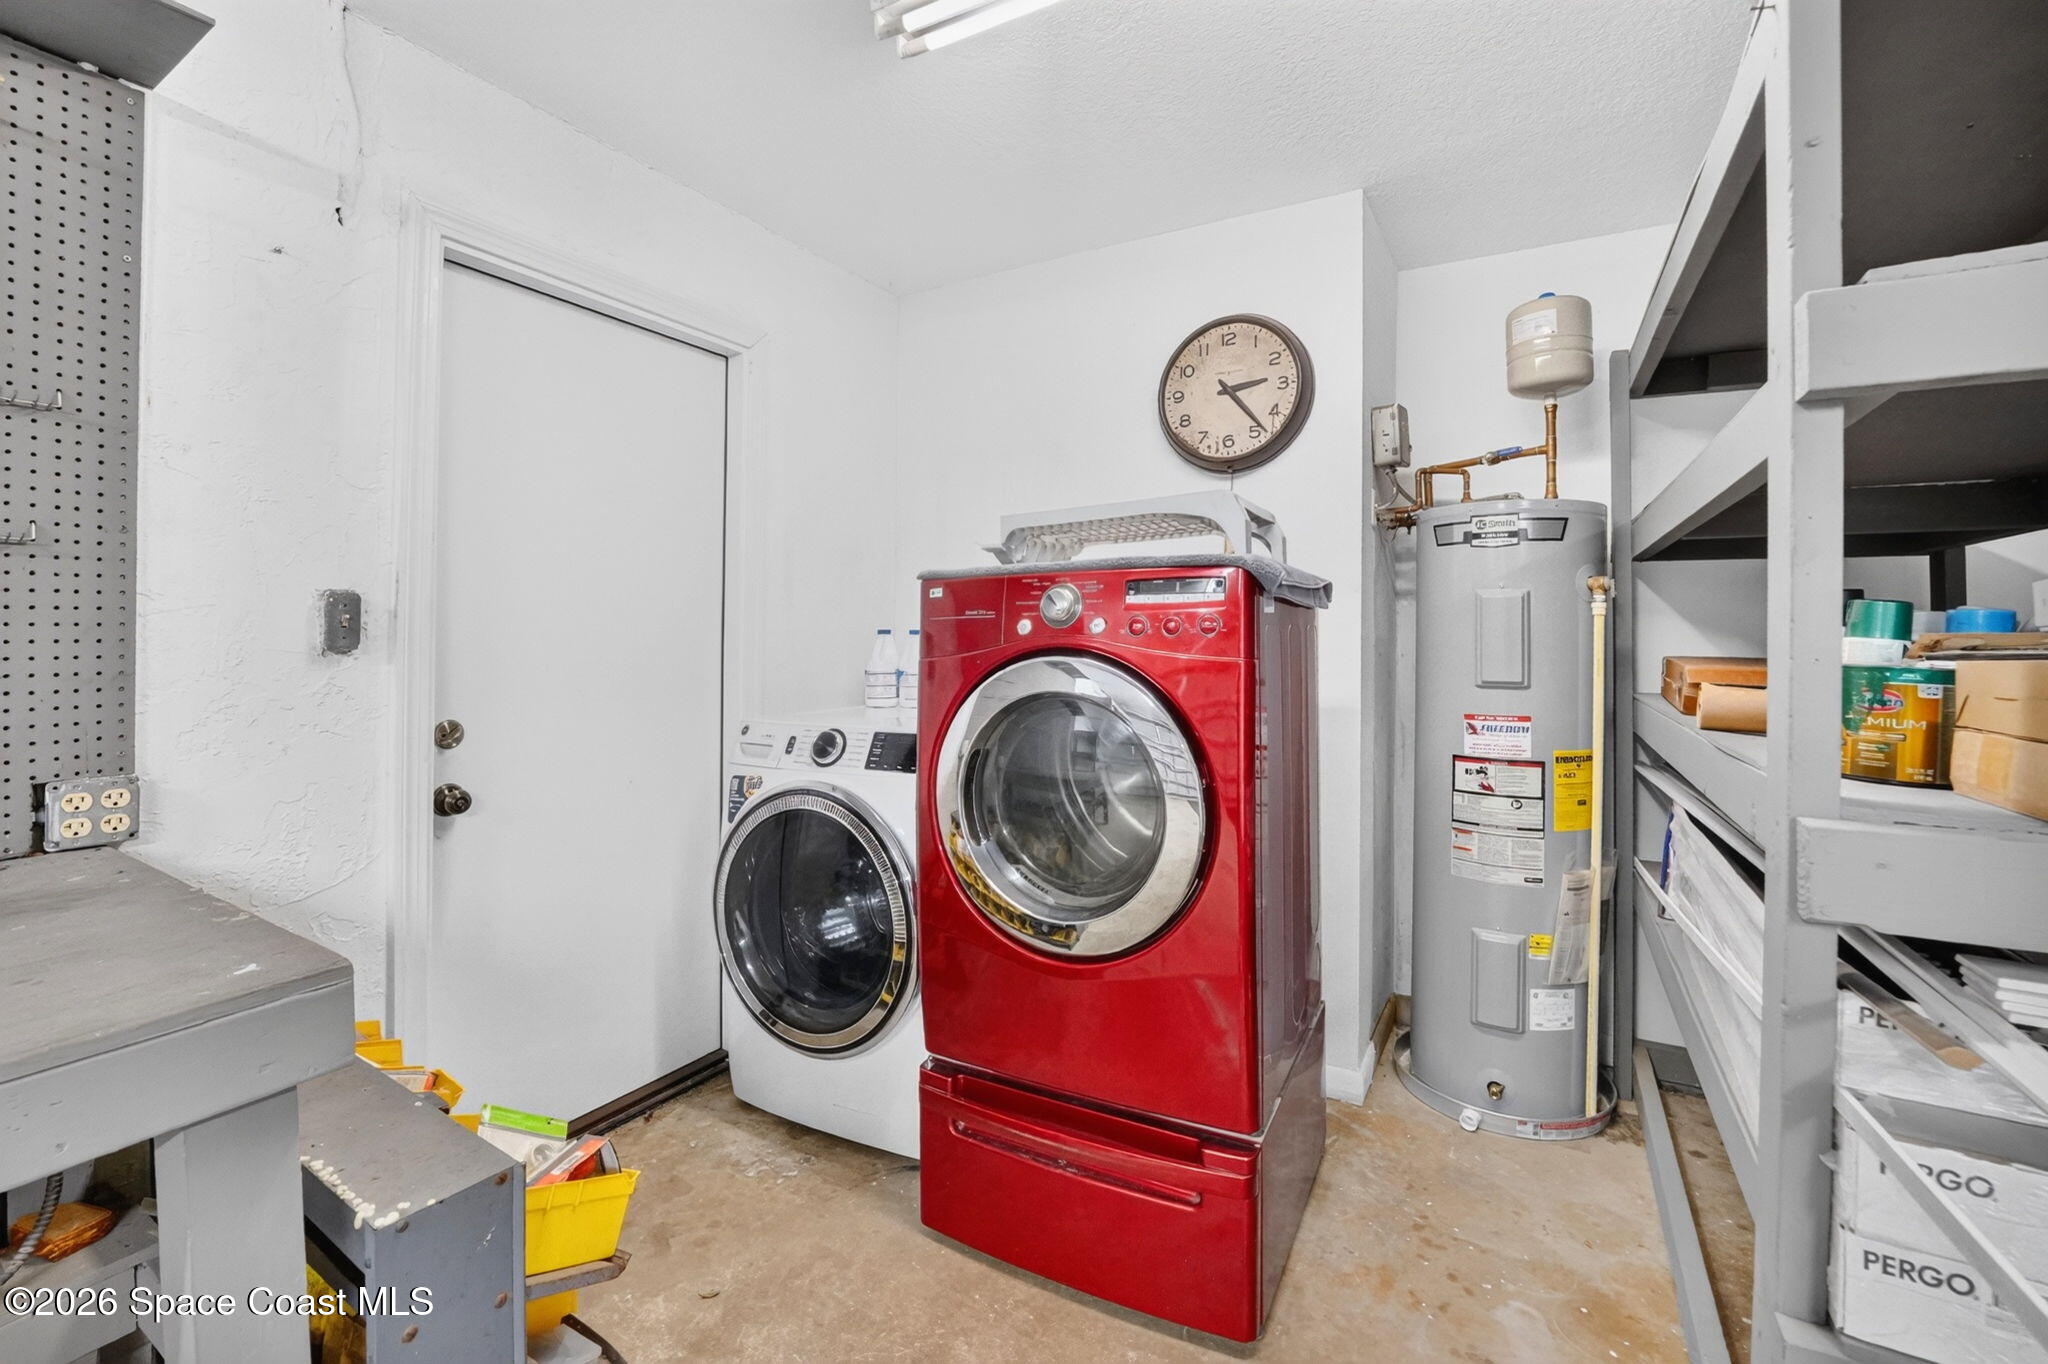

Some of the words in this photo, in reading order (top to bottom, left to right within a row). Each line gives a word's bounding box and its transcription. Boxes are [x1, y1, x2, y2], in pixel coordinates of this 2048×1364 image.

[1221, 332, 1236, 347] 12
[1253, 334, 1258, 348] 1
[1199, 342, 1209, 357] 11
[1268, 351, 1282, 366] 2
[1180, 364, 1195, 379] 10
[1277, 375, 1289, 390] 3
[1172, 390, 1185, 404] 9
[1268, 403, 1280, 417] 4
[1179, 414, 1191, 428] 8
[1198, 430, 1209, 444] 7
[1248, 425, 1263, 439] 5
[1222, 434, 1235, 448] 6
[1863, 1249, 1976, 1298] PERGO
